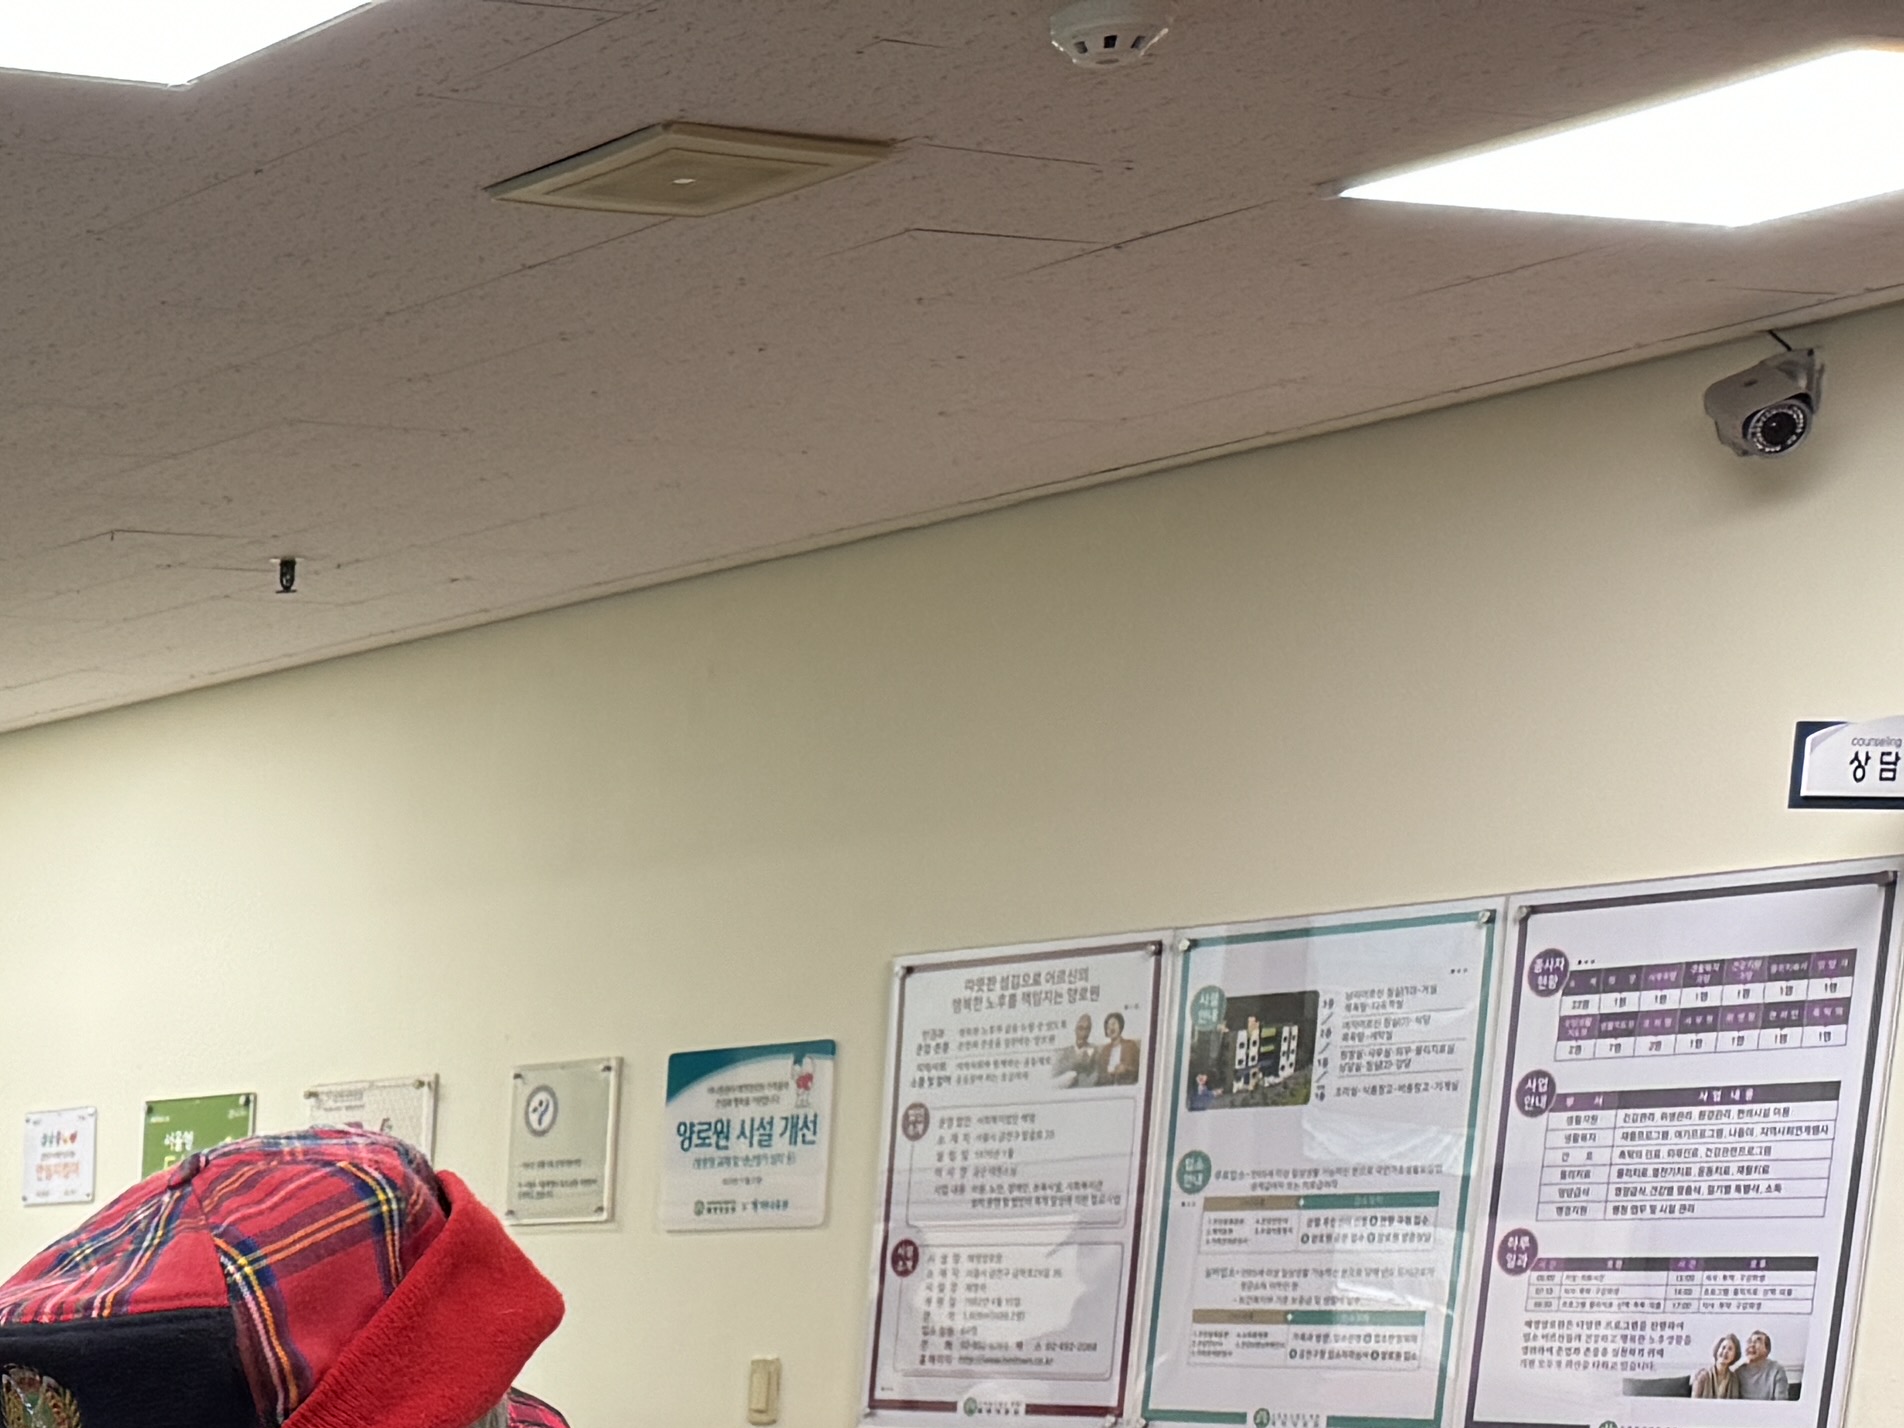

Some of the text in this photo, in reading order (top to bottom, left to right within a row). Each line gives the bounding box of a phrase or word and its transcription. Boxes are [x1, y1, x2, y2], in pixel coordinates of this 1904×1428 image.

[676, 1112, 819, 1152] 양로원 시설 개선
